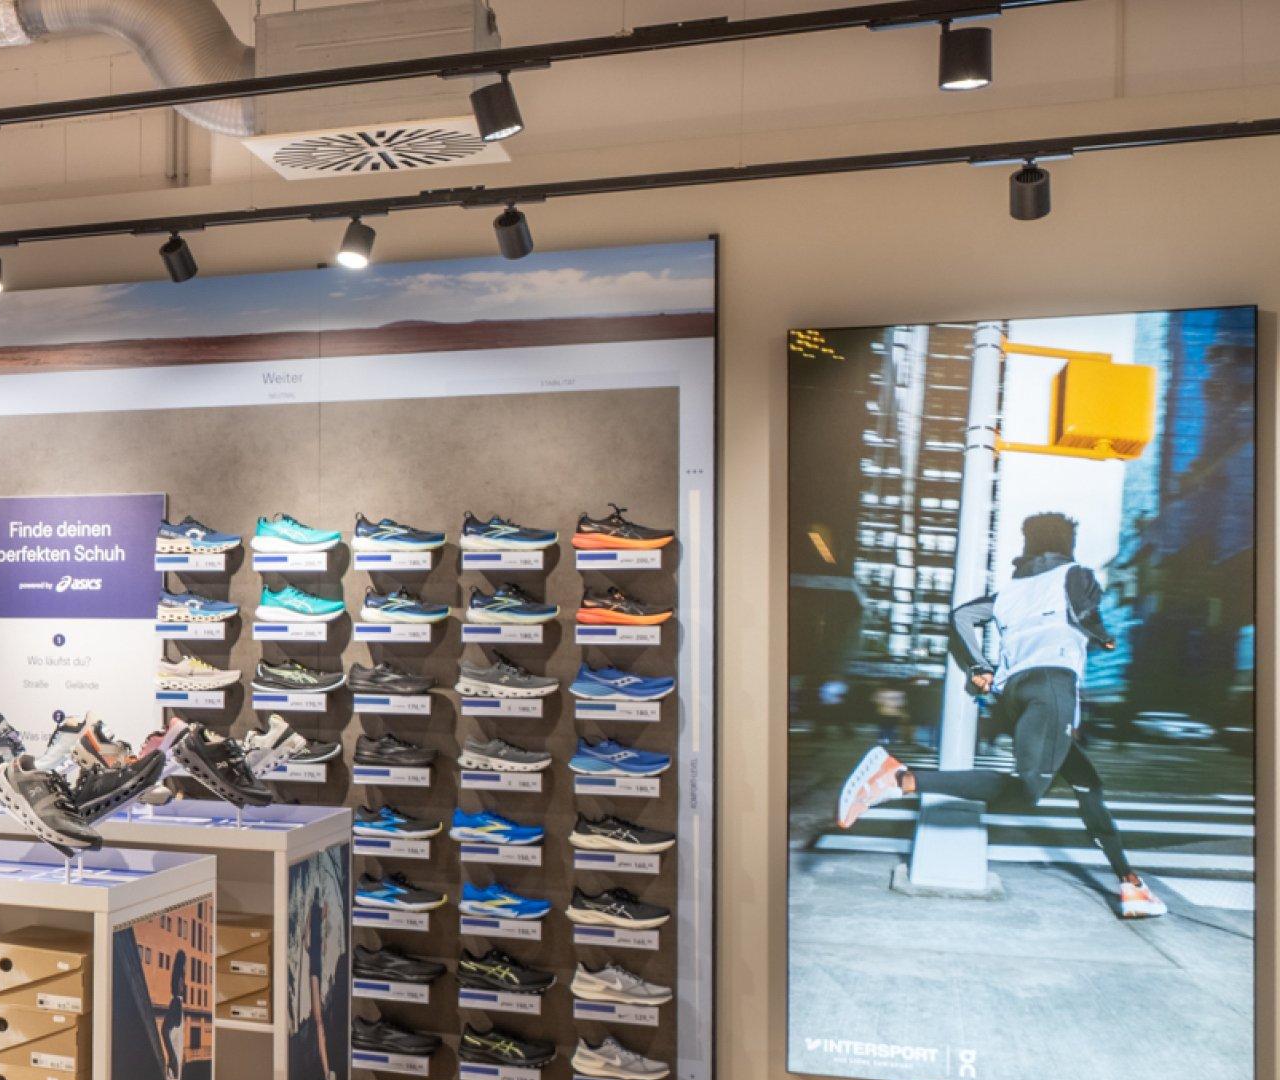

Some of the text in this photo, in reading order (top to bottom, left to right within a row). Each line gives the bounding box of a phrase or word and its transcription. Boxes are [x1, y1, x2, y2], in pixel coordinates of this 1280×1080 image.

[262, 371, 303, 385] Weiter
[9, 519, 112, 538] Finde deinen
[74, 543, 126, 562] Schuh
[27, 655, 43, 668] Wo
[72, 656, 92, 667] du?
[823, 1038, 939, 1063] INTERSPORT
